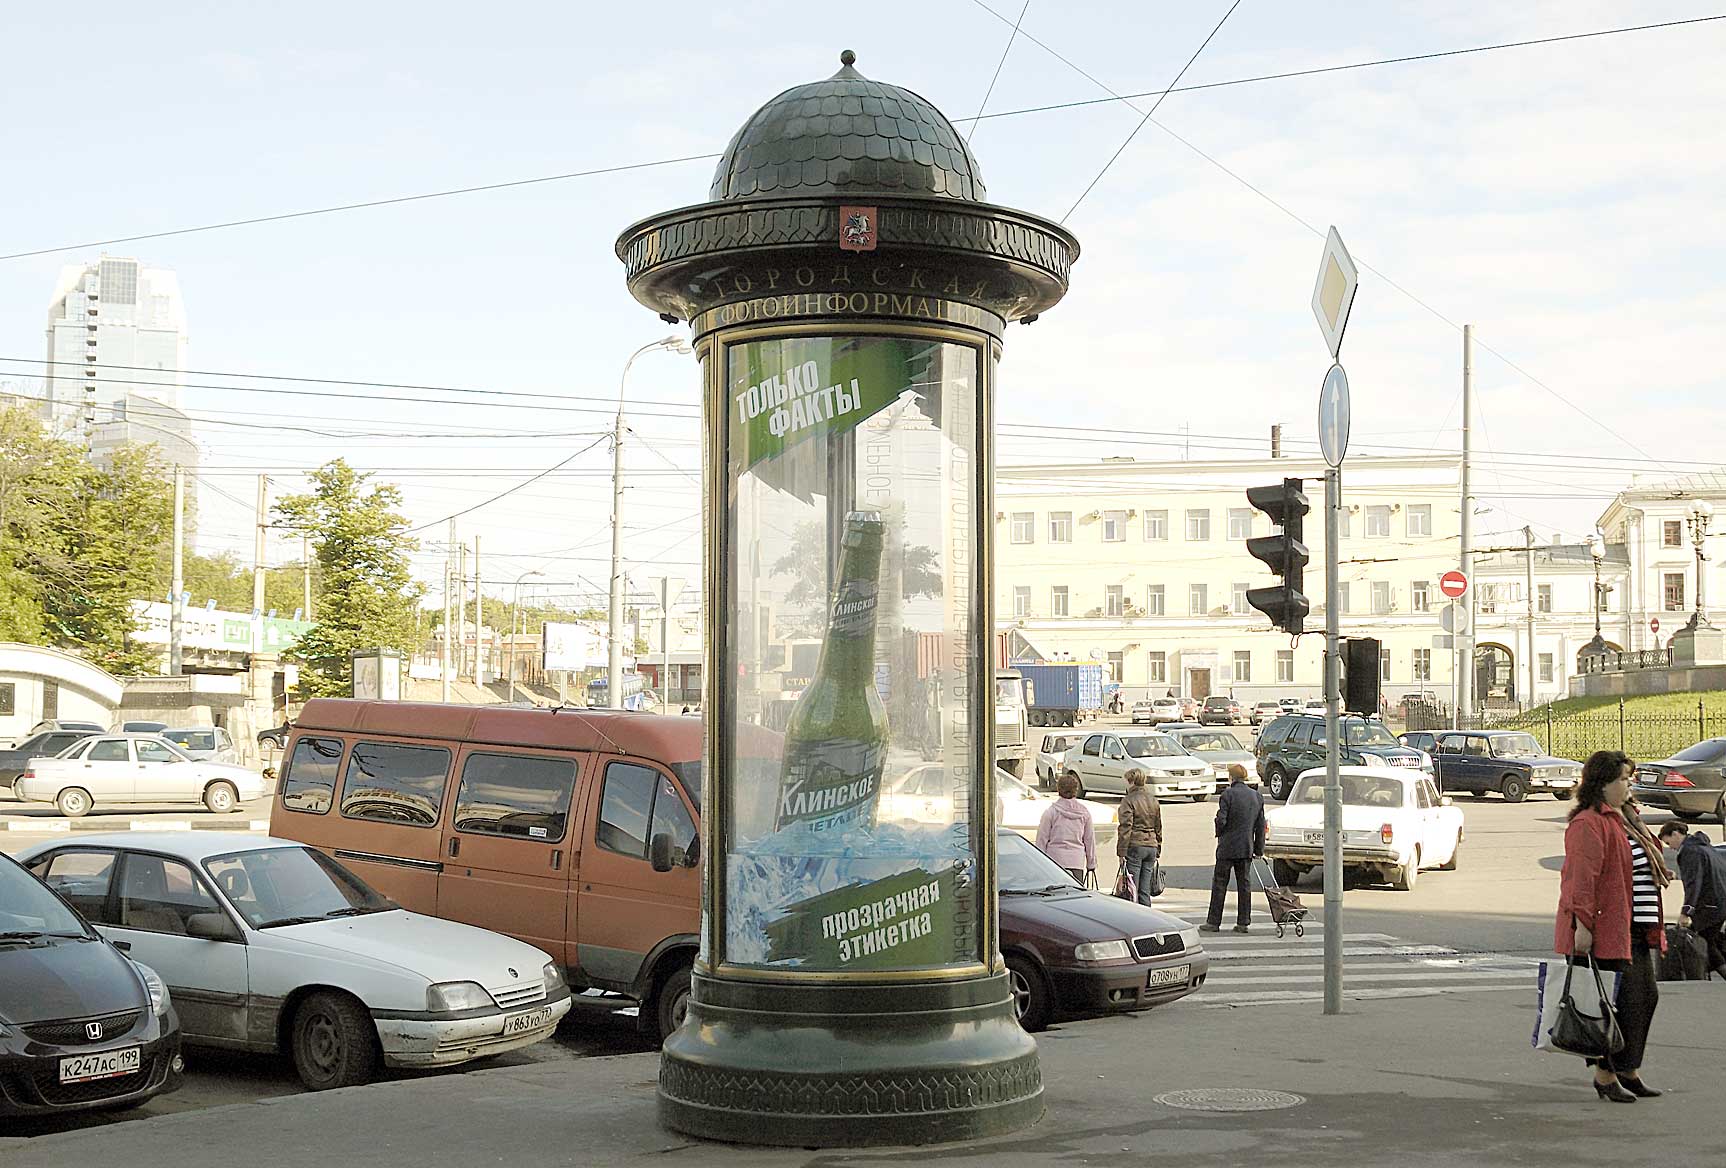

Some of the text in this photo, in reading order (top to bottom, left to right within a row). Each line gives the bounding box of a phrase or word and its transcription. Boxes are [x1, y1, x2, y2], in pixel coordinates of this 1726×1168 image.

[712, 264, 991, 299] ГОРОДСКАЯ
[720, 291, 981, 327] ФОТОИНФОРМАЦИЯ
[735, 359, 819, 424] ТОЛЬКО
[768, 378, 863, 439] ФАКТЫ
[952, 478, 971, 623] УПОТРЕБЛЕНИЕ
[952, 685, 971, 762] ВРЕДИТ
[780, 773, 875, 817] КЛИНСКОЕ
[952, 765, 972, 853] ВАШЕМУ
[821, 879, 941, 939] прозрачная
[838, 911, 932, 962] этикетка
[64, 1057, 116, 1077] К247АС
[119, 1050, 137, 1064] 199
